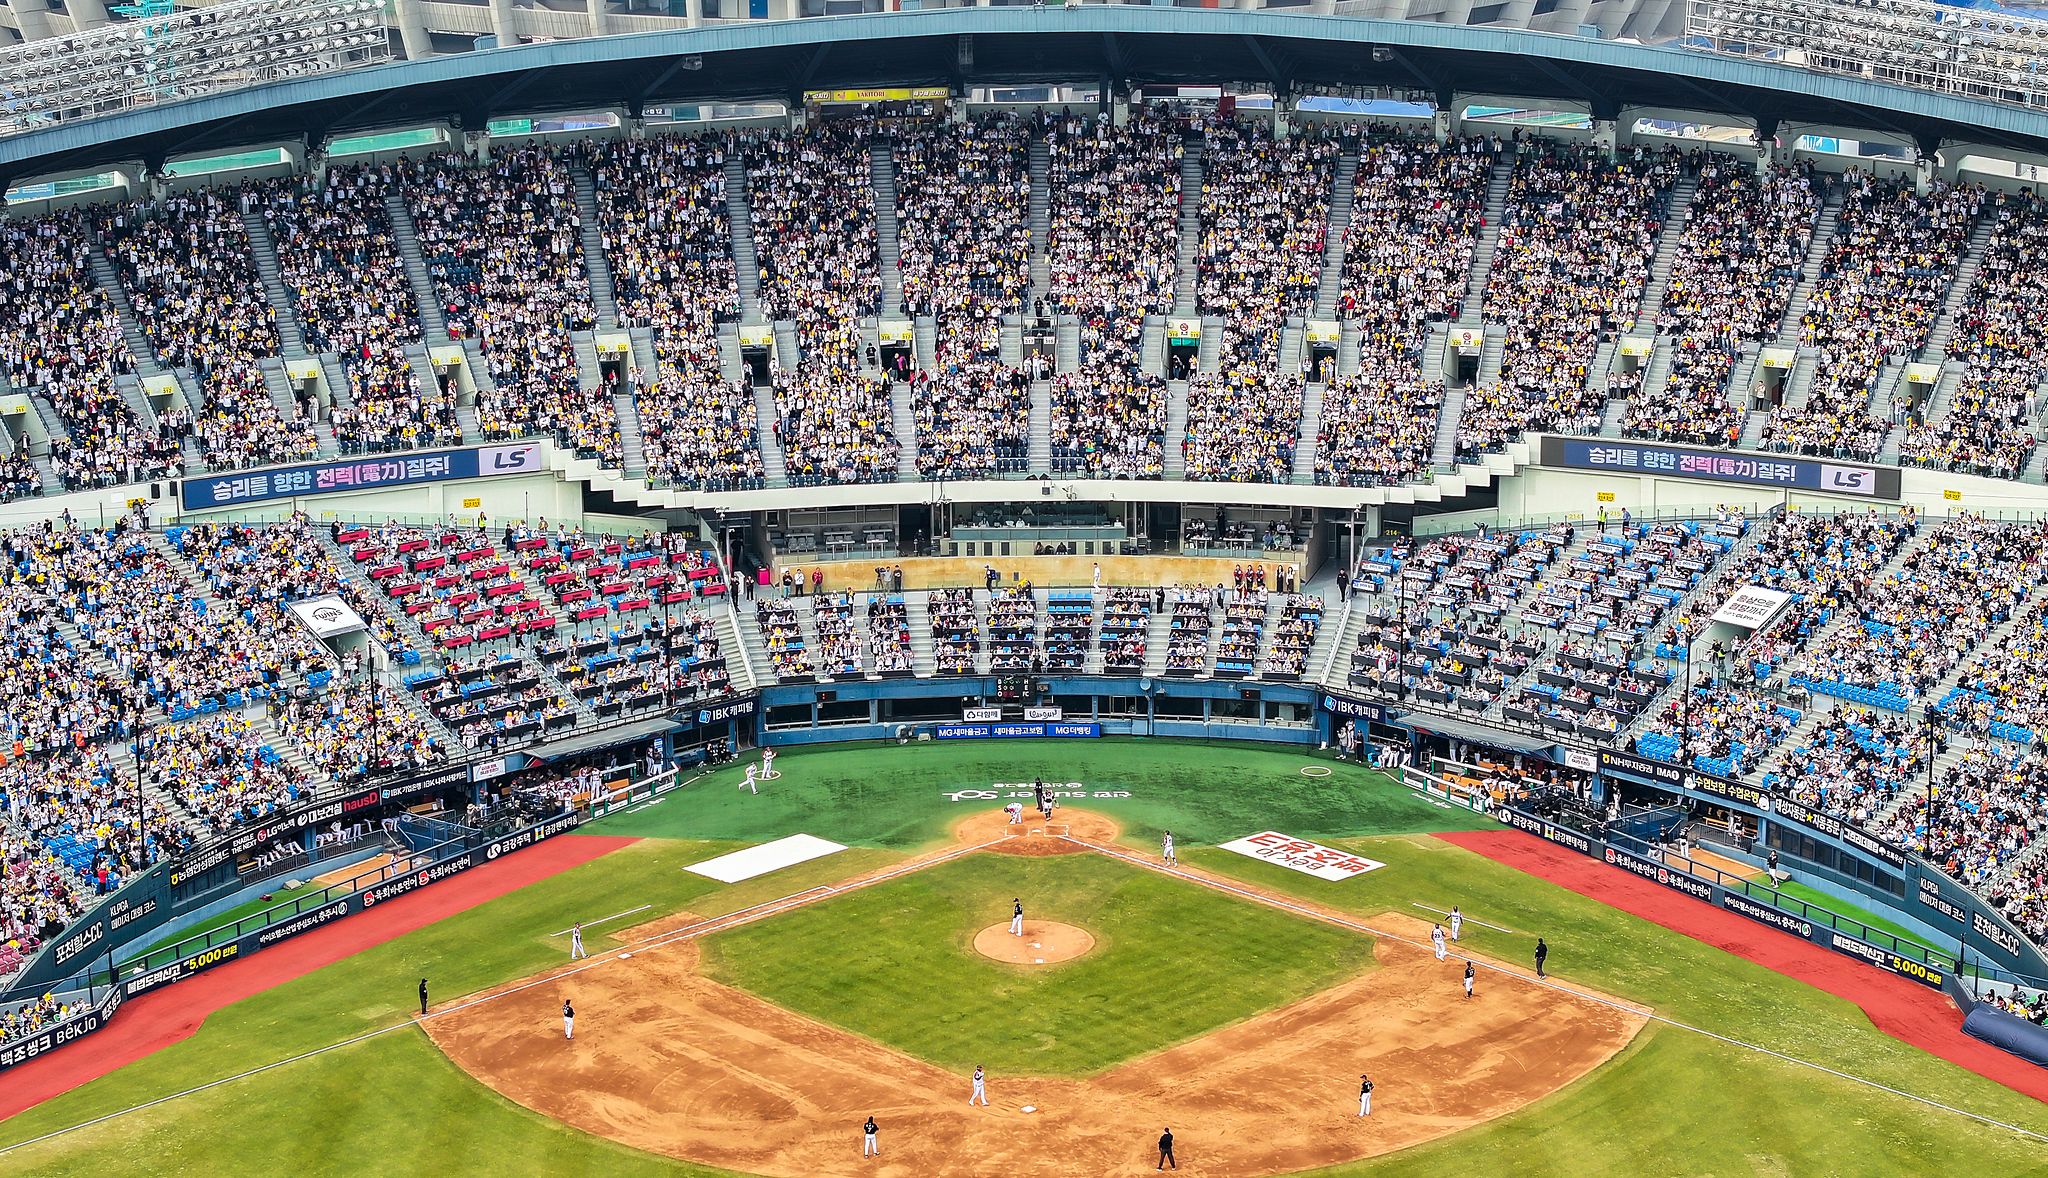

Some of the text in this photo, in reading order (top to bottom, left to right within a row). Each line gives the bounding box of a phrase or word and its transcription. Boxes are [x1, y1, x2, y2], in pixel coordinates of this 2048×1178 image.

[494, 448, 532, 468] LS
[1588, 446, 1796, 482] 승리를 향한 전력(電力)질주!
[212, 455, 450, 501] 승리를 향한 전력(電力)질주!
[1832, 471, 1868, 488] LS
[312, 609, 343, 620] TWINS
[712, 702, 754, 720] IBK캐피탈
[1338, 700, 1379, 719] IBK캐피탈
[938, 728, 988, 737] MG새마을금고
[994, 726, 1043, 735] 새마을금고보험
[1055, 726, 1091, 735] MG더뱅킹
[1610, 756, 1653, 774] NH투자증권
[390, 771, 467, 797] IBK기업은행 IBK나라사랑카드
[1004, 790, 1087, 798] suer
[1695, 776, 1760, 804] 수협보험 수협은행
[308, 802, 342, 824] 대보건설
[344, 792, 378, 812] hausD
[266, 816, 296, 838] LG이노텍
[545, 814, 578, 836] 금강펜테리움
[1512, 814, 1540, 834] 금강주택
[1775, 798, 1840, 836] 태성자동문 자동중문
[231, 838, 258, 854] THE NEXT
[232, 832, 254, 848] ENABLE
[502, 832, 531, 852] 금강주택
[1554, 830, 1588, 852] 금강펜테리움
[178, 848, 230, 882] 농협안성팜랜드
[428, 854, 470, 880] 육회바른연어
[1615, 853, 1657, 879] 육회바른연어
[374, 875, 418, 900] 육회바른연어
[1668, 874, 1712, 900] 육회바른연어
[1920, 878, 1939, 896] KLPGA
[110, 900, 128, 917] KLPGA
[110, 900, 156, 930] 메이저 대회 코스
[318, 905, 338, 922] 충주시
[1920, 890, 1965, 923] 메이저 대회 코스
[1782, 916, 1802, 934] 충주시
[1973, 912, 2020, 957] 포천힐스CC
[56, 921, 102, 964] 포천힐스CC
[127, 964, 180, 994] 불법도박신고
[190, 948, 222, 970] 5,000
[222, 944, 238, 958] 만원
[1832, 934, 1885, 964] 불법도박신고
[1893, 956, 1926, 978] 5,000
[1926, 972, 1942, 985] 만원
[102, 988, 122, 1022] 백조씽크
[0, 1034, 52, 1066] 백조씽크
